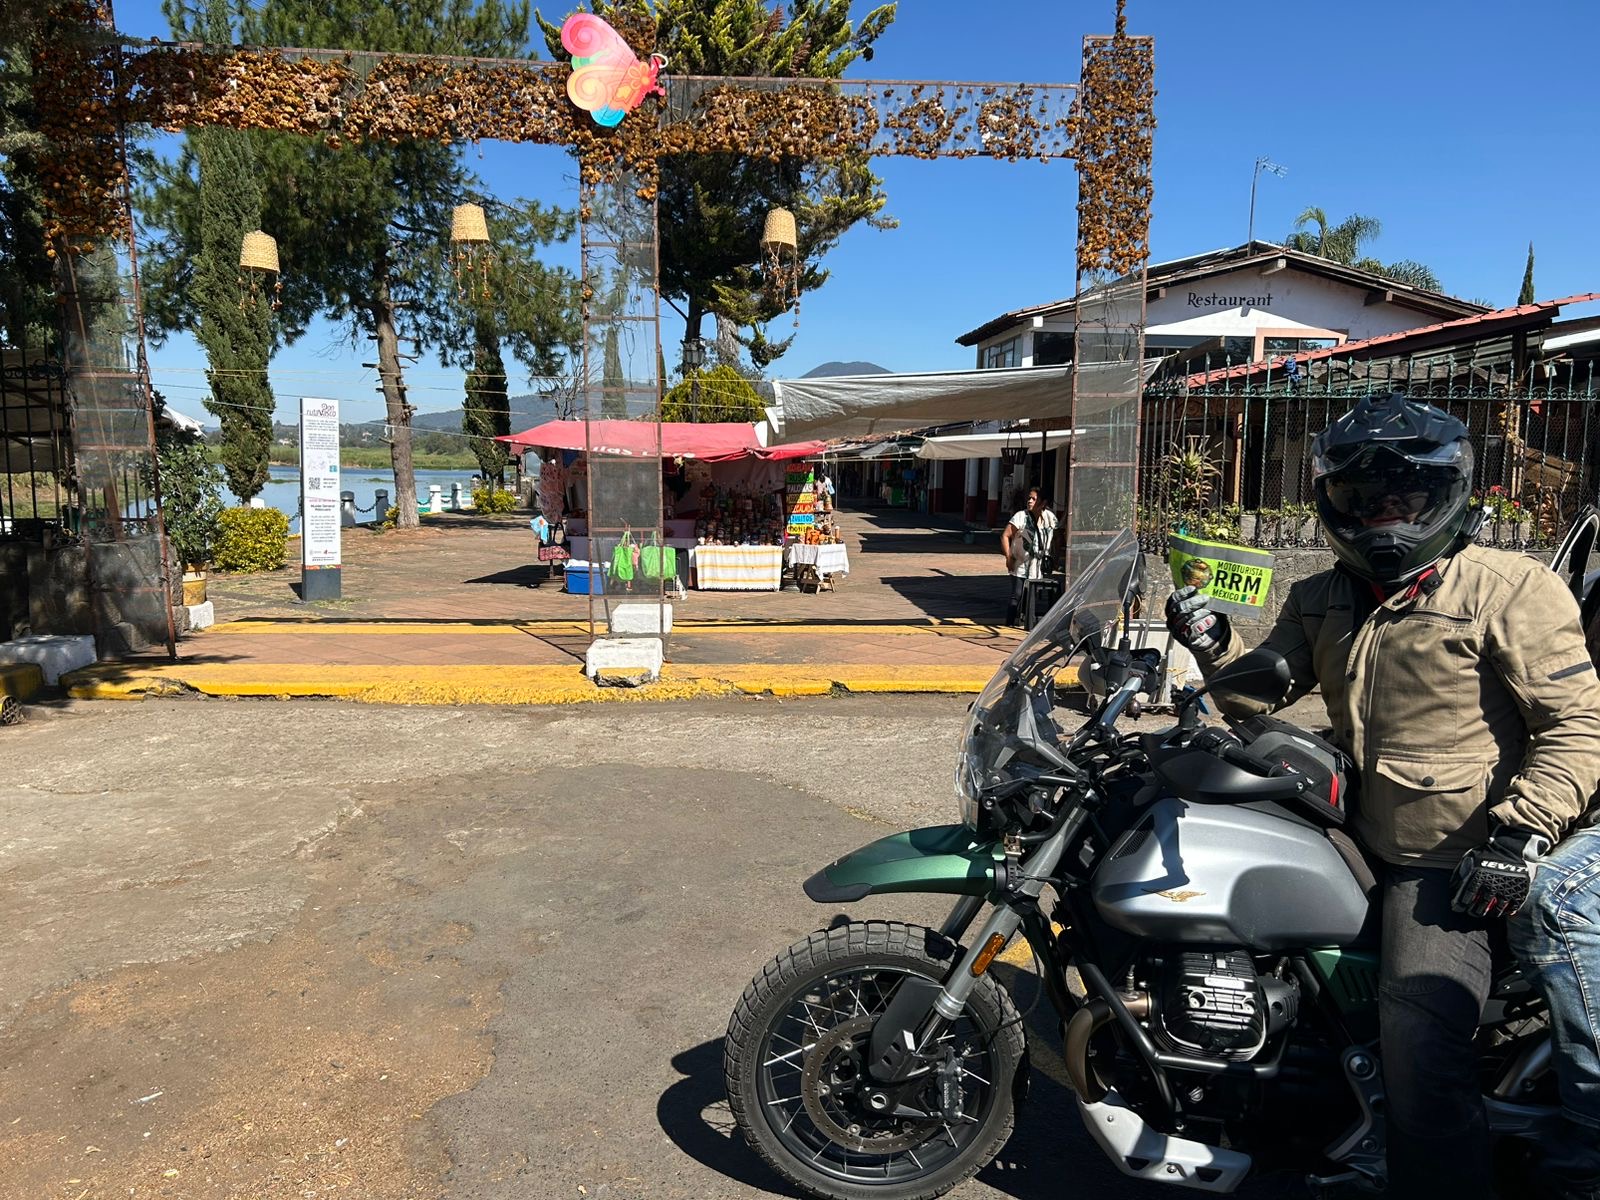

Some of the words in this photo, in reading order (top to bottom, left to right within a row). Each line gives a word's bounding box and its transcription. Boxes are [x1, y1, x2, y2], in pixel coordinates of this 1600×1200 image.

[1187, 292, 1273, 308] Restaurant
[1217, 561, 1263, 577] MOTOTURISTA
[1214, 570, 1262, 595] RRM
